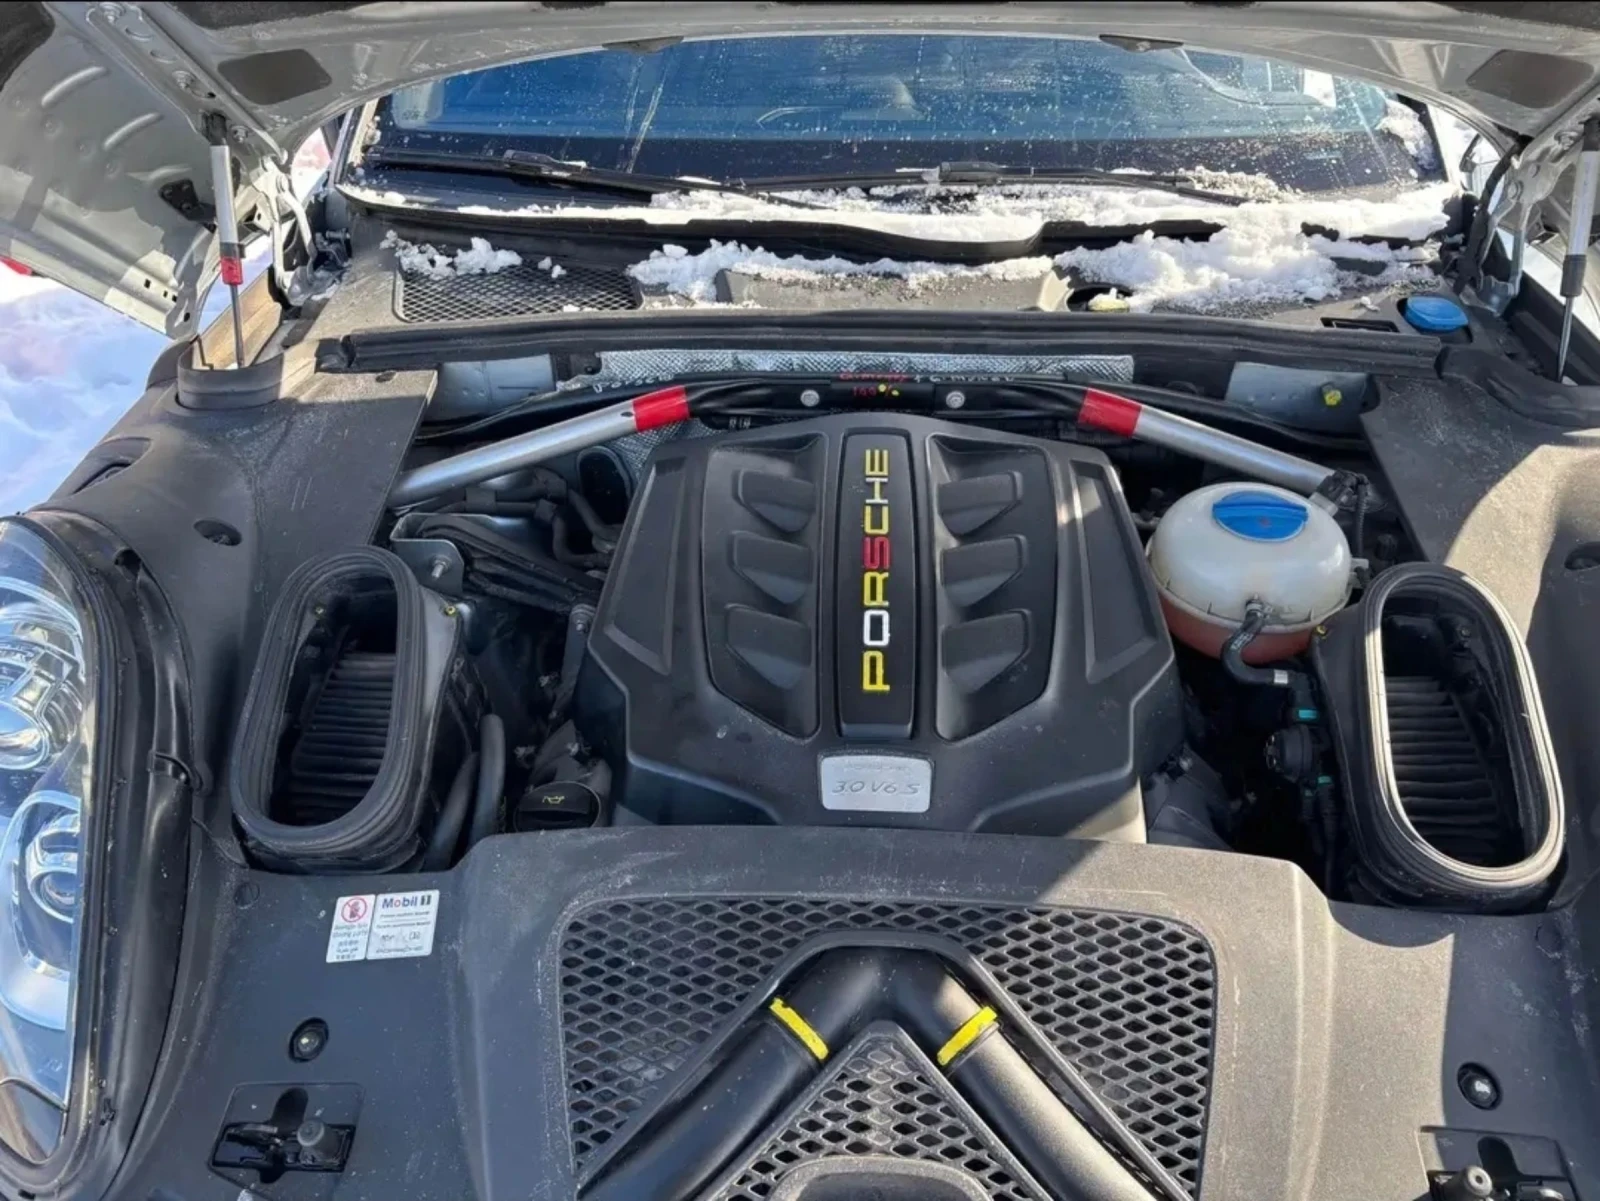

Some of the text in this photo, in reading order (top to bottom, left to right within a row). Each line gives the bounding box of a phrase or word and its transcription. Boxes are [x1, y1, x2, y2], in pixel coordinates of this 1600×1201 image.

[862, 449, 891, 691] PORSCHE
[871, 780, 898, 795] V6
[899, 783, 921, 796] S
[381, 895, 418, 909] Mobil
